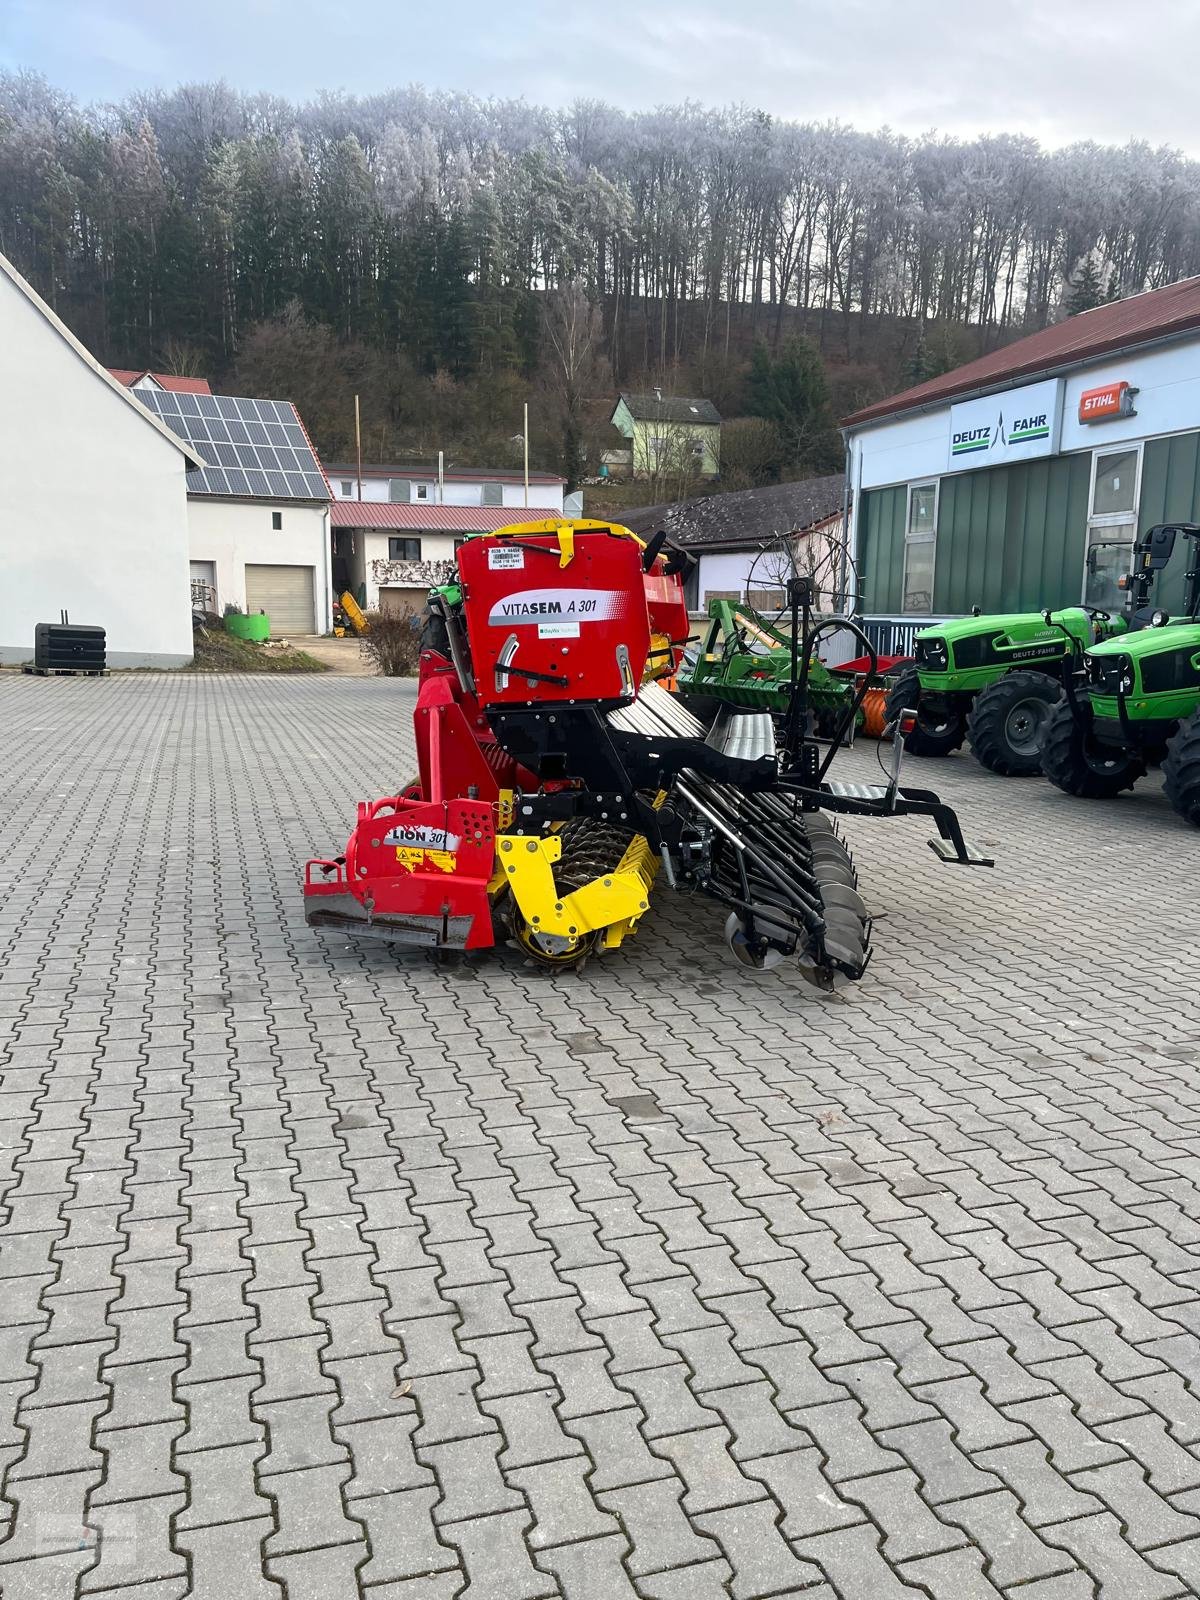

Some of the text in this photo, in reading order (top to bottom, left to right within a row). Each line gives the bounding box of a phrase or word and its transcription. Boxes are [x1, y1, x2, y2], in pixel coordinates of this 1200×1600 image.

[1084, 393, 1115, 411] STIHL
[953, 414, 1047, 444] DEUTZ FAHR
[502, 600, 597, 616] VITASEM A 301
[1013, 647, 1056, 659] DEUTZ-FAHR
[393, 829, 426, 842] LION
